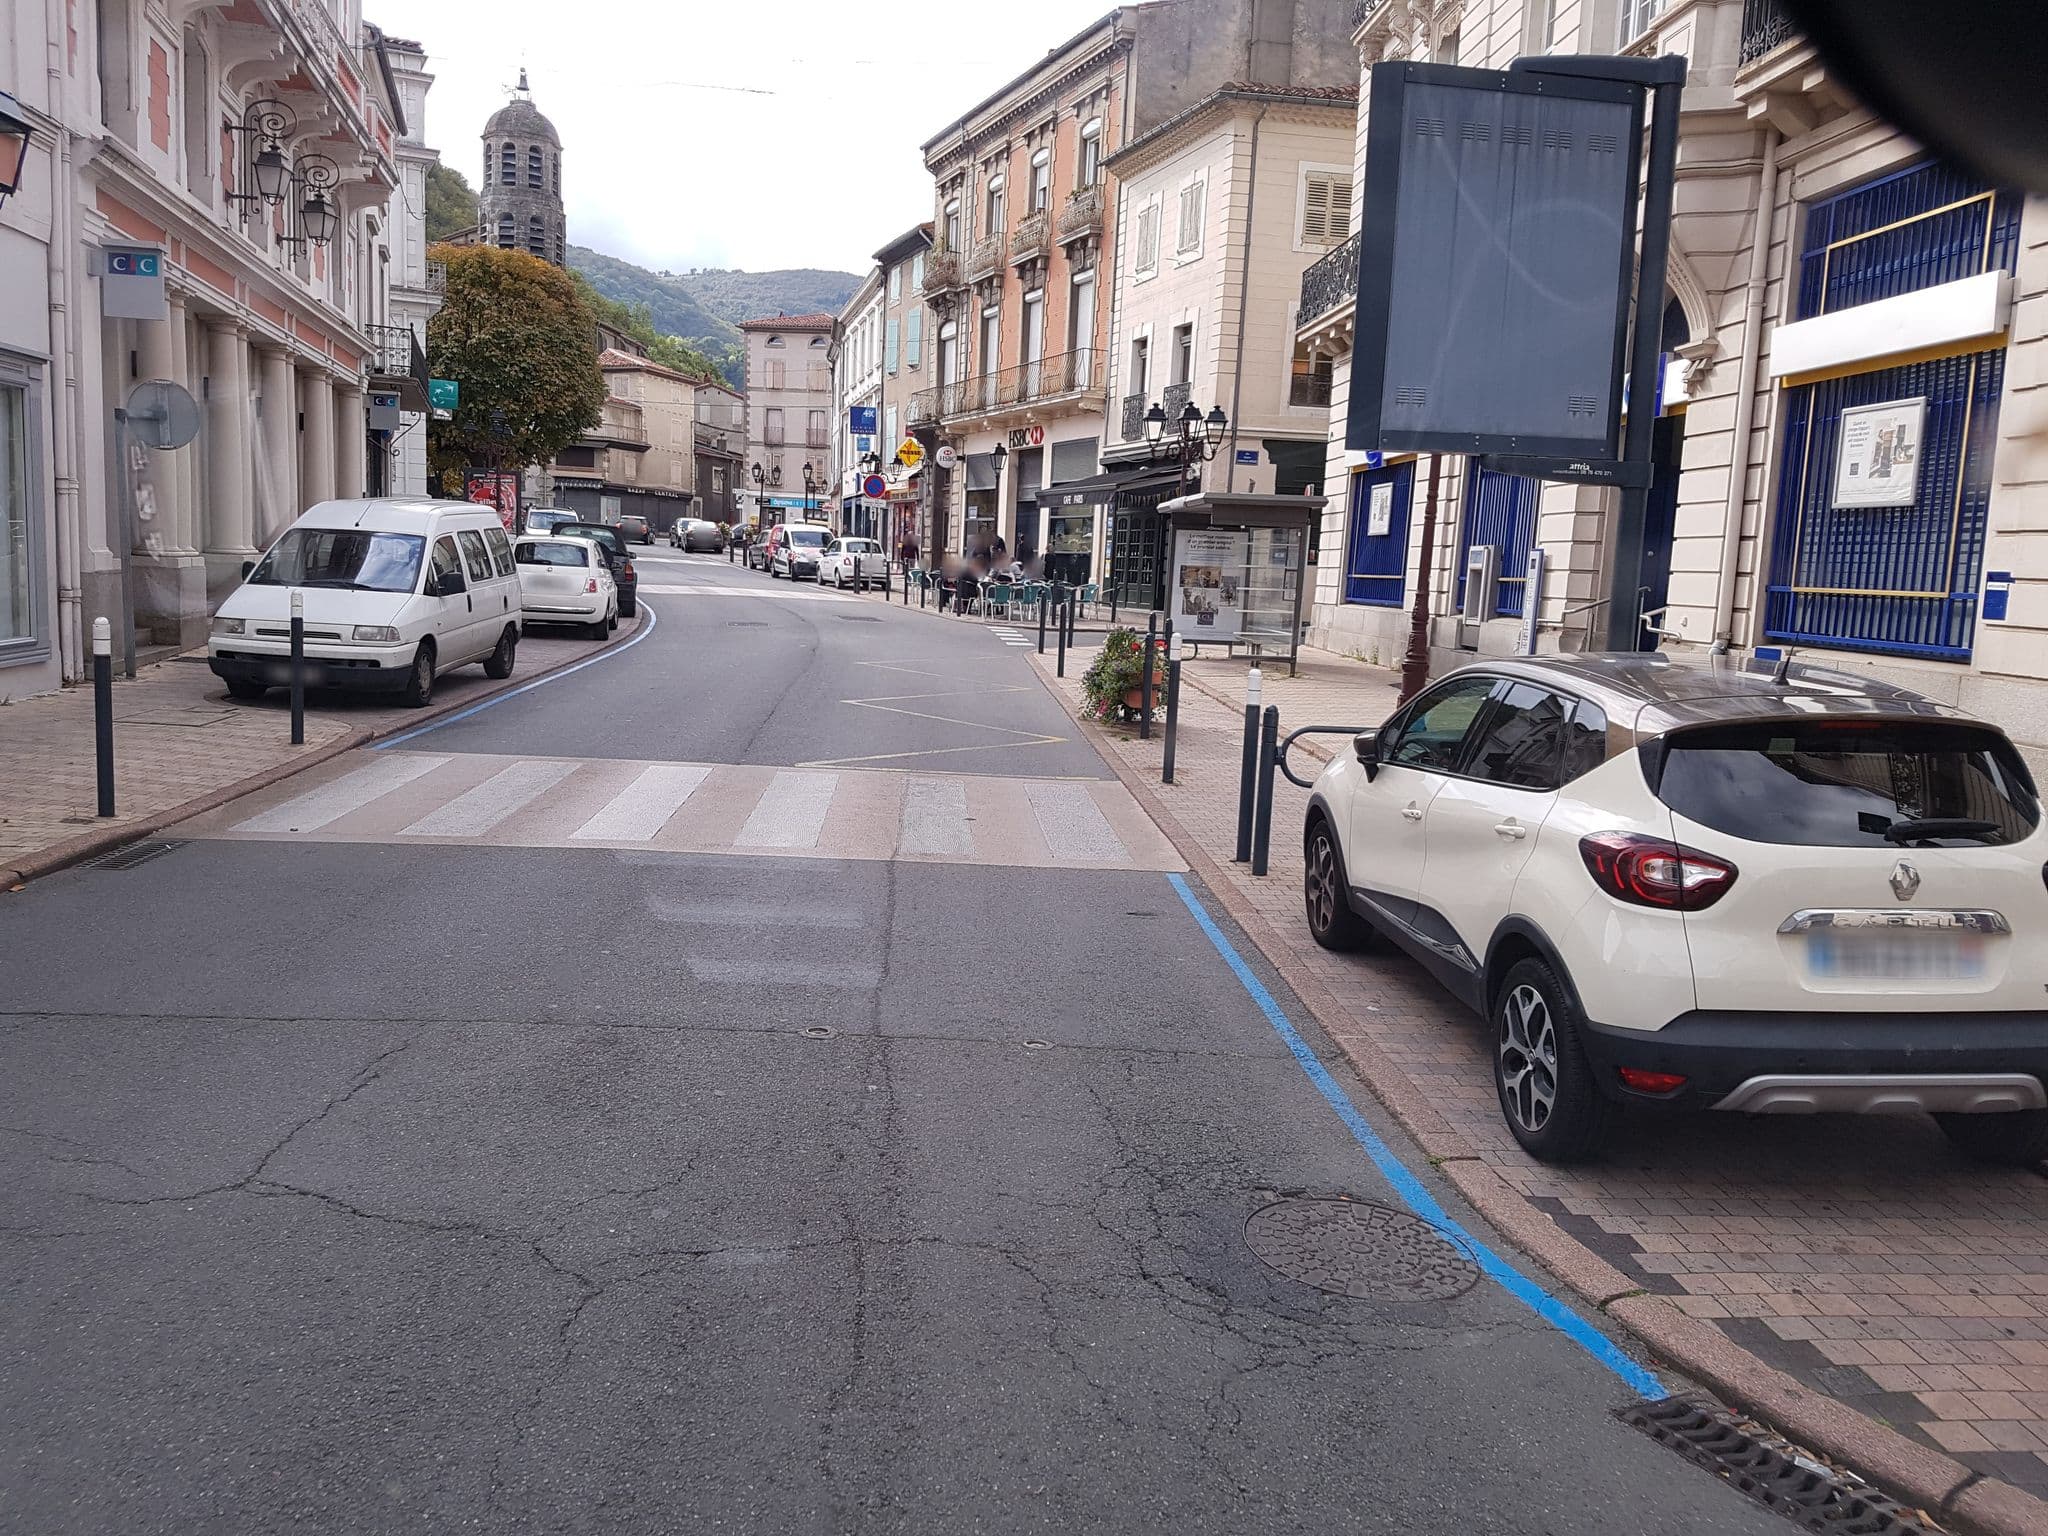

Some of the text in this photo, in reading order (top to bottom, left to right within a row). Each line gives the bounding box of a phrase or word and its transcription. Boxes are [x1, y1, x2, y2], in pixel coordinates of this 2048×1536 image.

[1008, 428, 1031, 448] HSBC
[654, 490, 679, 498] CENTRAL
[1833, 916, 1982, 930] CAPTUR
